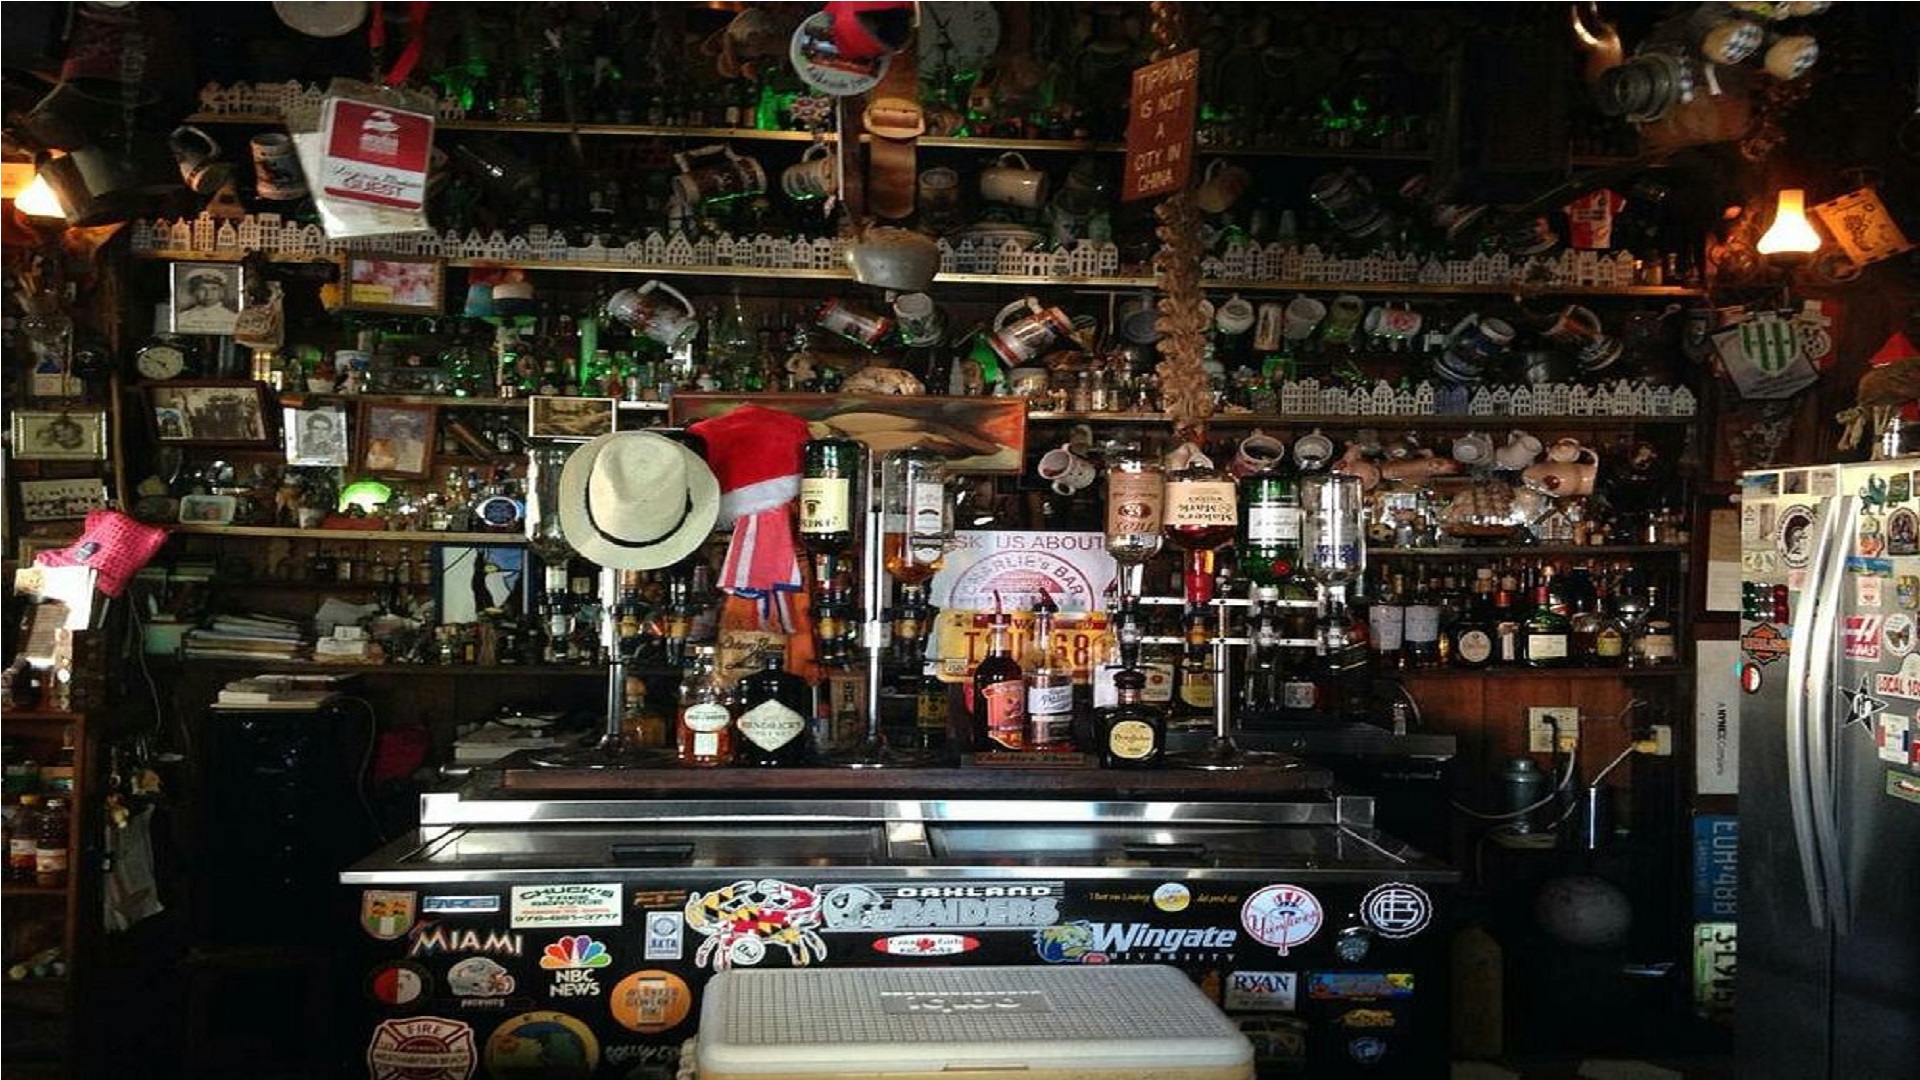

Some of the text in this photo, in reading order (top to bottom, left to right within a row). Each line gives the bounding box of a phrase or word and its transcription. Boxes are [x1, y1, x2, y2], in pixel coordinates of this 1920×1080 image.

[1138, 57, 1197, 95] TIPPING
[1140, 88, 1186, 119] IS NOT
[1155, 121, 1167, 141] A
[1134, 142, 1183, 172] CITY IN
[1137, 167, 1173, 193] CHINA
[995, 536, 1026, 549] US
[1031, 536, 1106, 551] ABOUT
[1053, 567, 1085, 596] BAR
[519, 886, 615, 900] CHUCK'S
[897, 886, 1051, 898] OAKLAND
[892, 897, 1061, 928] RAIDERS
[410, 927, 524, 957] MIAMI
[1087, 922, 1238, 954] Wingate
[555, 968, 594, 982] NBC
[1234, 975, 1291, 993] RYAN
[549, 982, 600, 997] NEWS
[406, 1023, 443, 1035] FIRE
